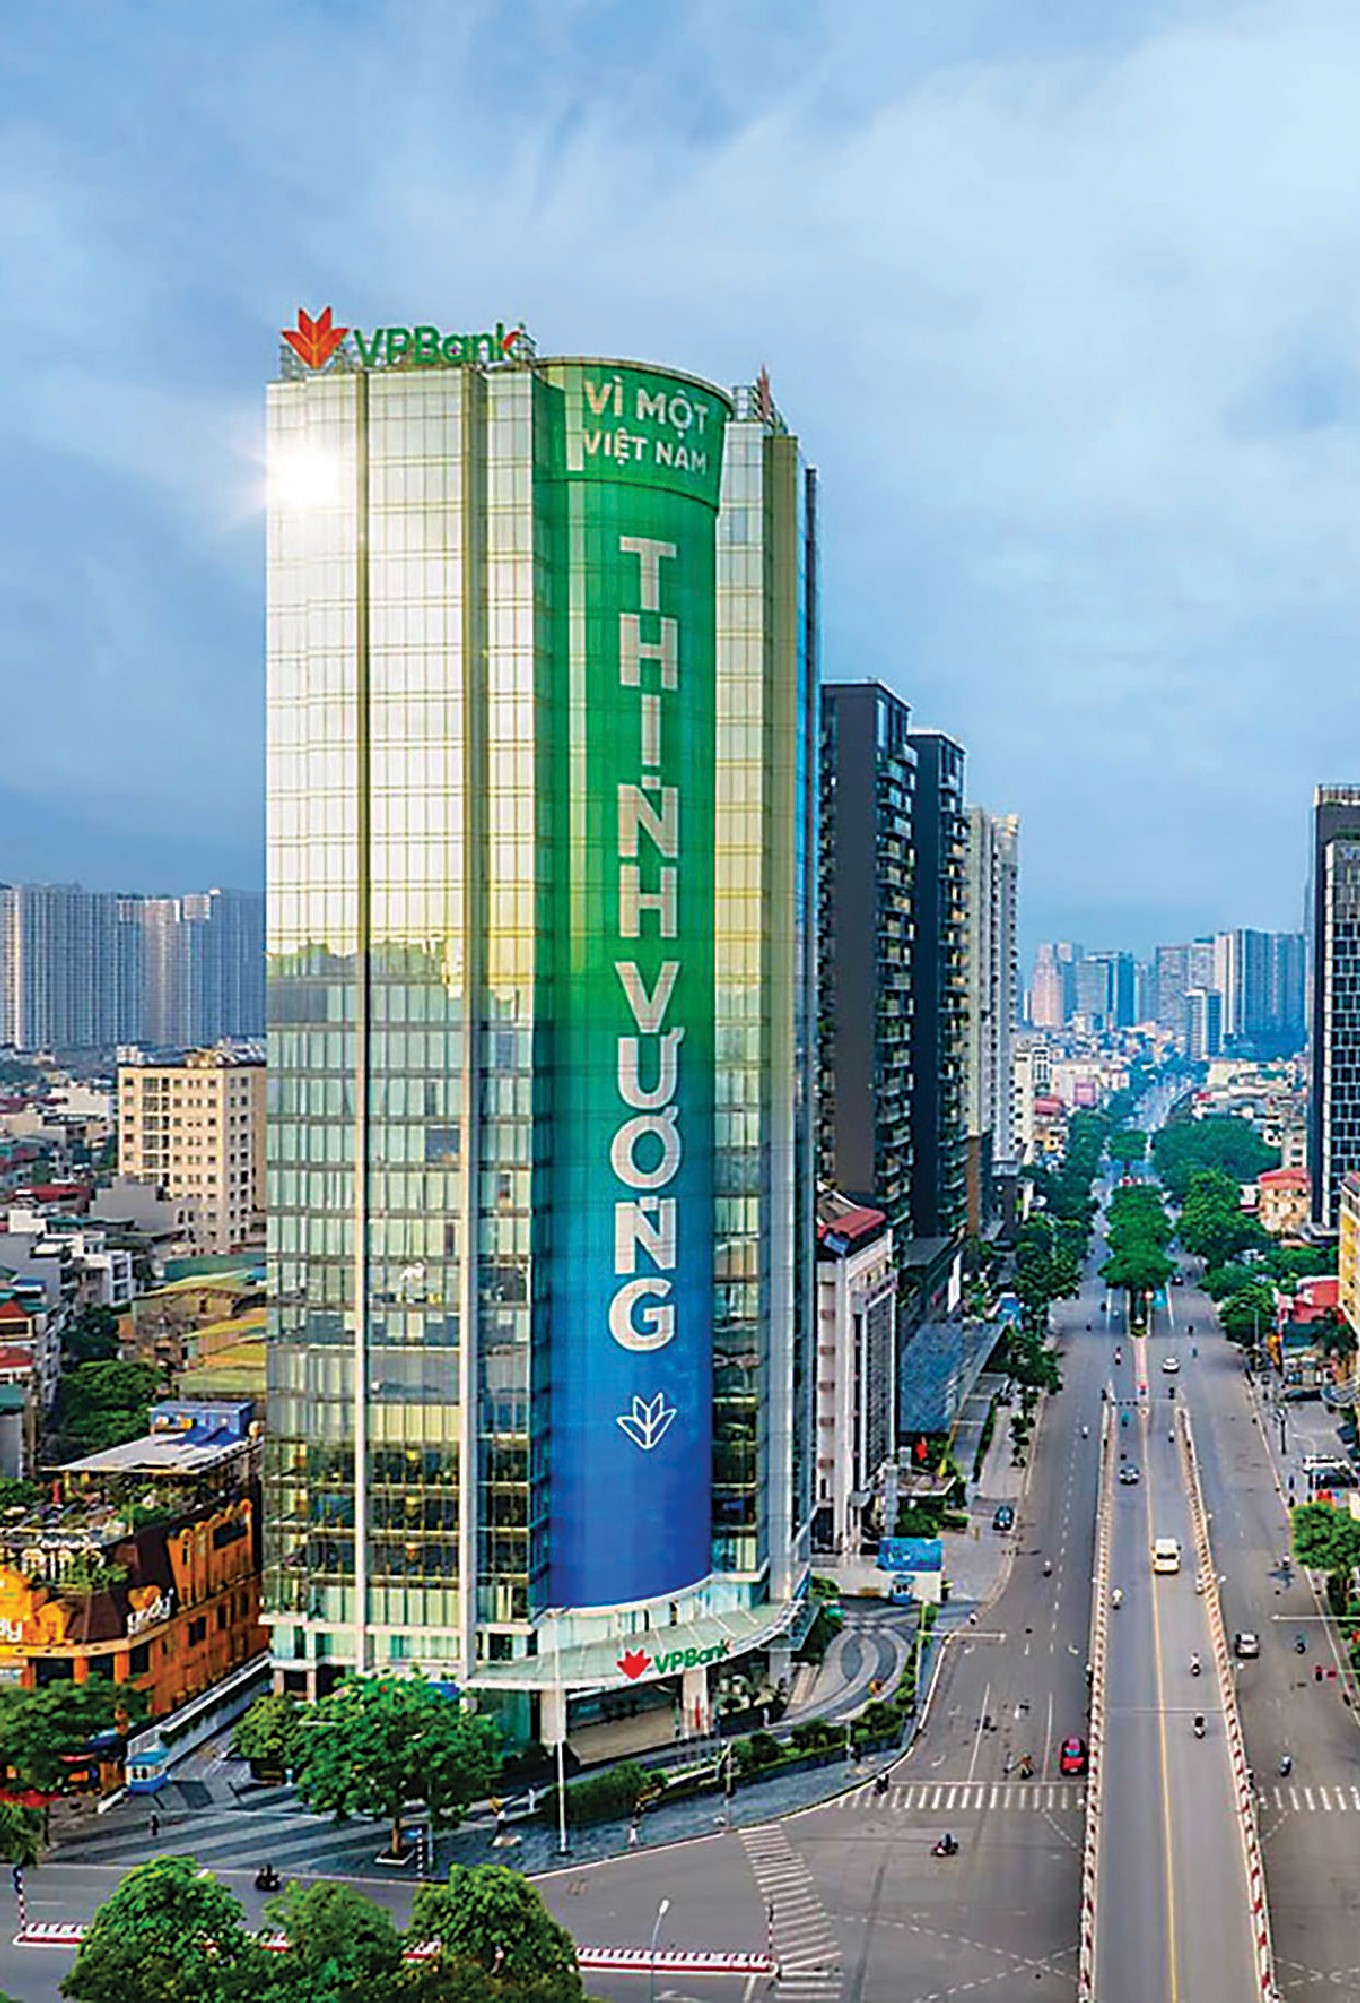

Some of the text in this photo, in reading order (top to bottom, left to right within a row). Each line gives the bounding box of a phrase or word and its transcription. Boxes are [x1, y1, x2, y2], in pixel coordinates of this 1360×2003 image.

[353, 322, 524, 367] VPBank
[584, 375, 709, 438] VÌ MỘT
[583, 427, 706, 476] VIỆT NAM
[608, 536, 685, 1351] THỊNH VƯỢNG
[653, 1638, 730, 1674] VPBank
